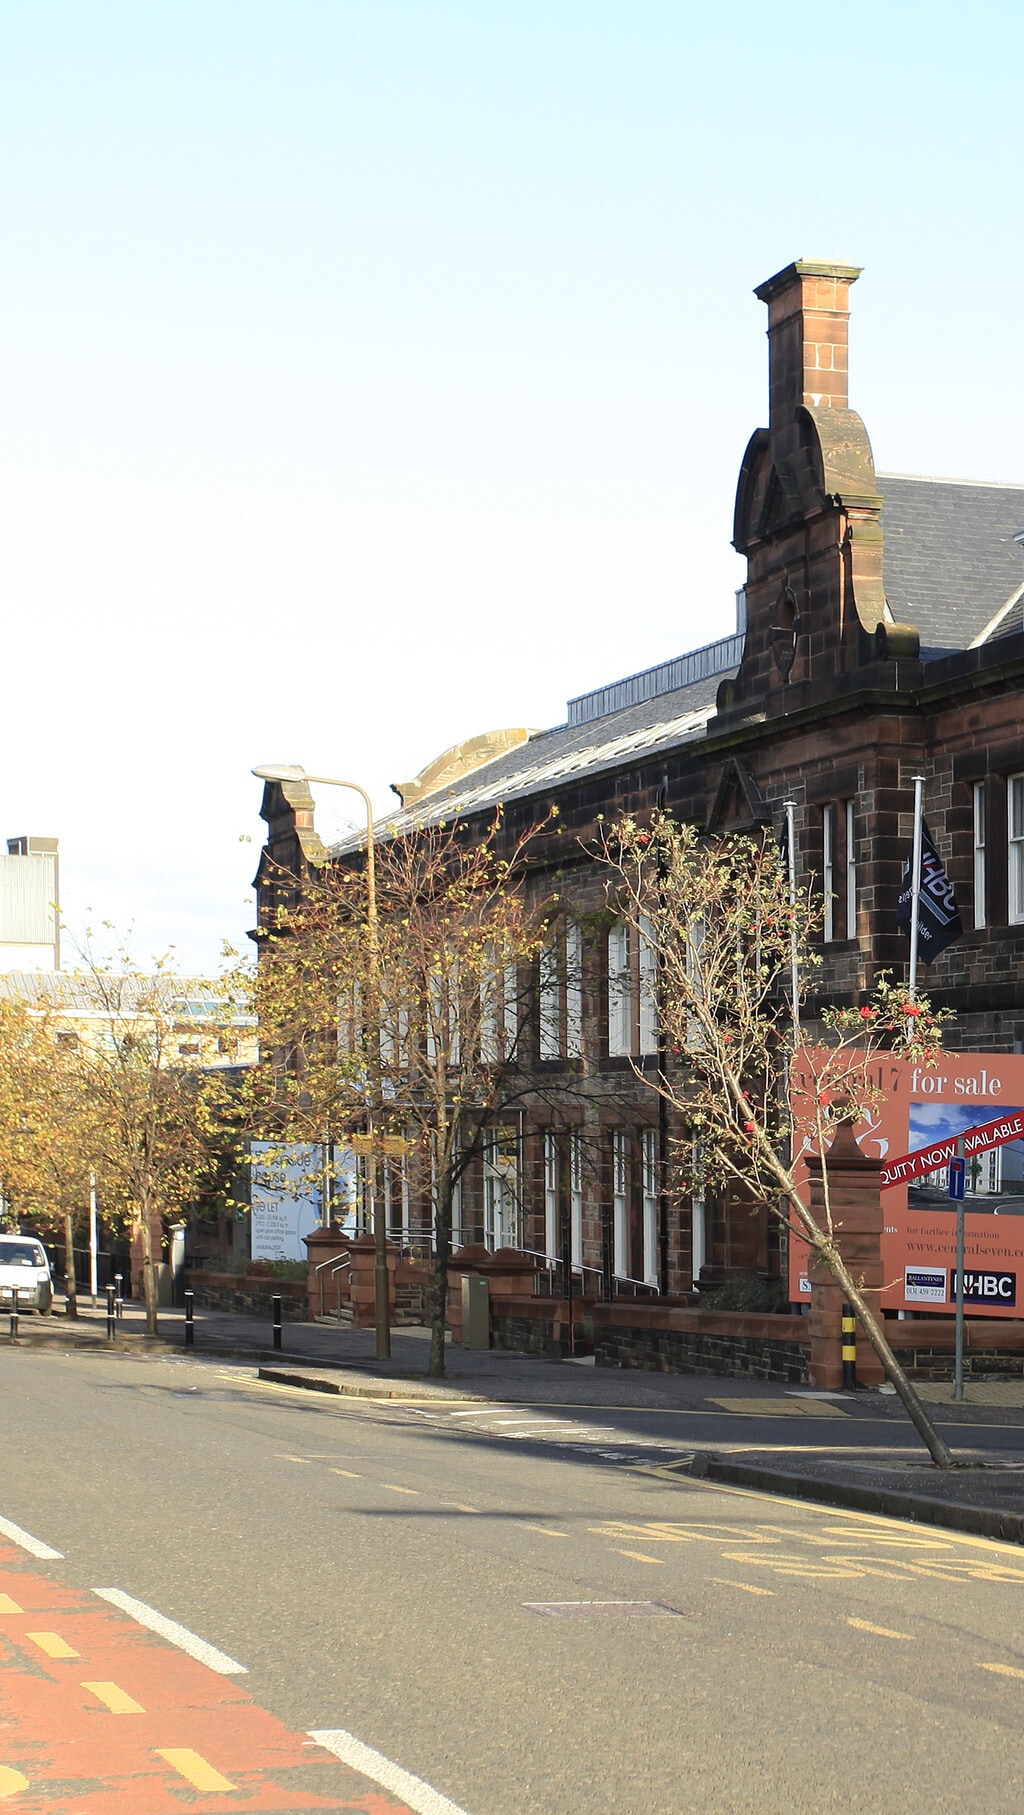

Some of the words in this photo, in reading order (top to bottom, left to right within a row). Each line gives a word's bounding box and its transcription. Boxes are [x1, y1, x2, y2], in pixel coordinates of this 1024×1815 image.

[890, 1068, 902, 1092] 7
[910, 1068, 948, 1094] for
[954, 1070, 1001, 1096] sale
[920, 1143, 956, 1169] NOW
[267, 1202, 278, 1213] LET
[920, 1227, 948, 1236] further
[931, 1288, 944, 1296] 2222
[954, 1274, 1012, 1297] NHBC
